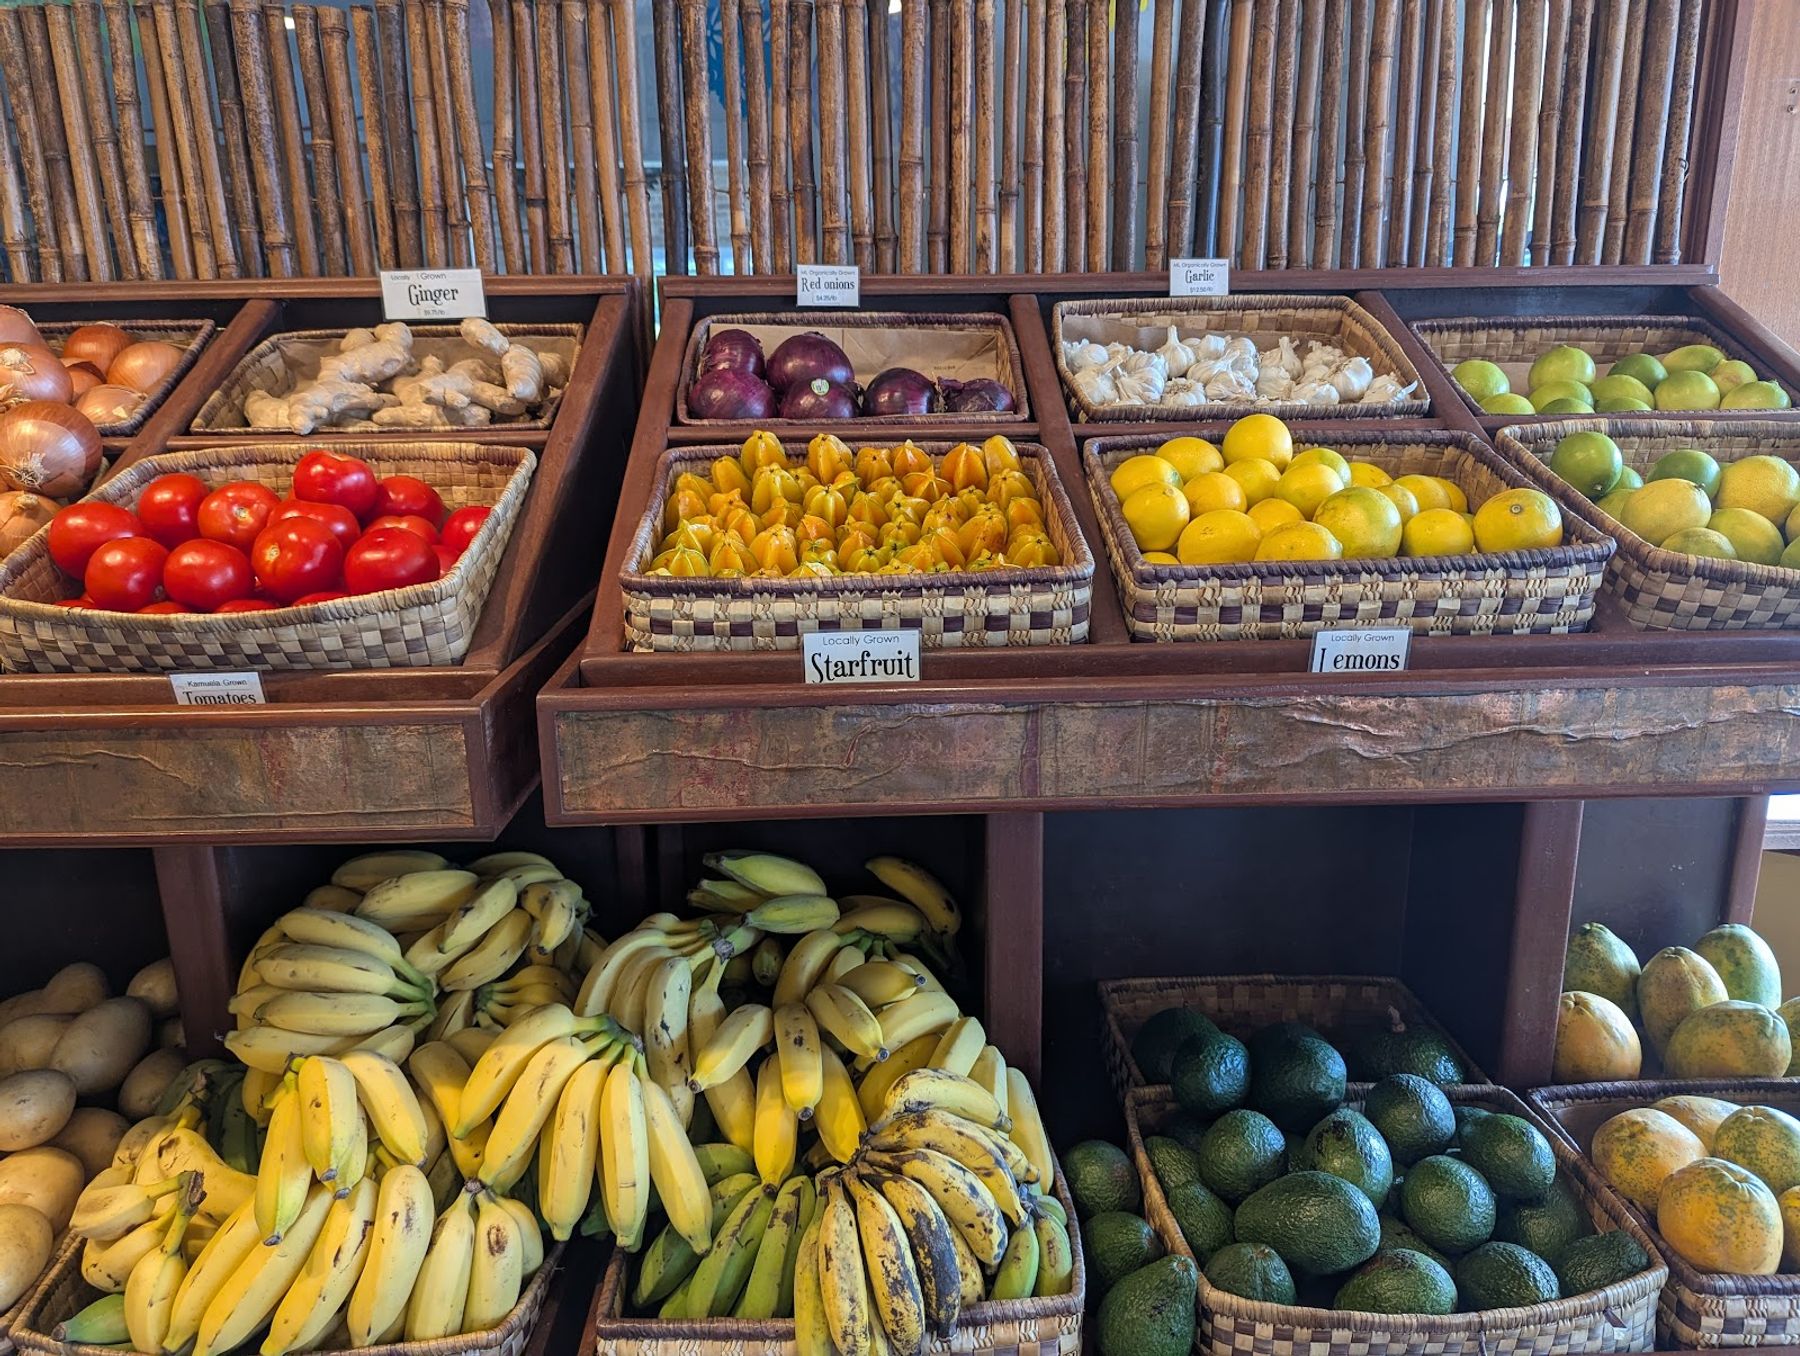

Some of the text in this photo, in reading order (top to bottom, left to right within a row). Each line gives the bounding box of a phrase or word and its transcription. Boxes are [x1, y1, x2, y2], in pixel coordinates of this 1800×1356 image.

[420, 272, 447, 280] Grown
[1185, 269, 1215, 284] Garlic
[801, 277, 855, 292] Red onions
[408, 283, 459, 306] Ginger
[822, 634, 900, 646] Locally Grown
[1331, 633, 1395, 643] Locally Grown
[811, 650, 915, 683] Starfruit
[222, 678, 248, 687] Grown
[182, 691, 257, 705] Tomatoes
